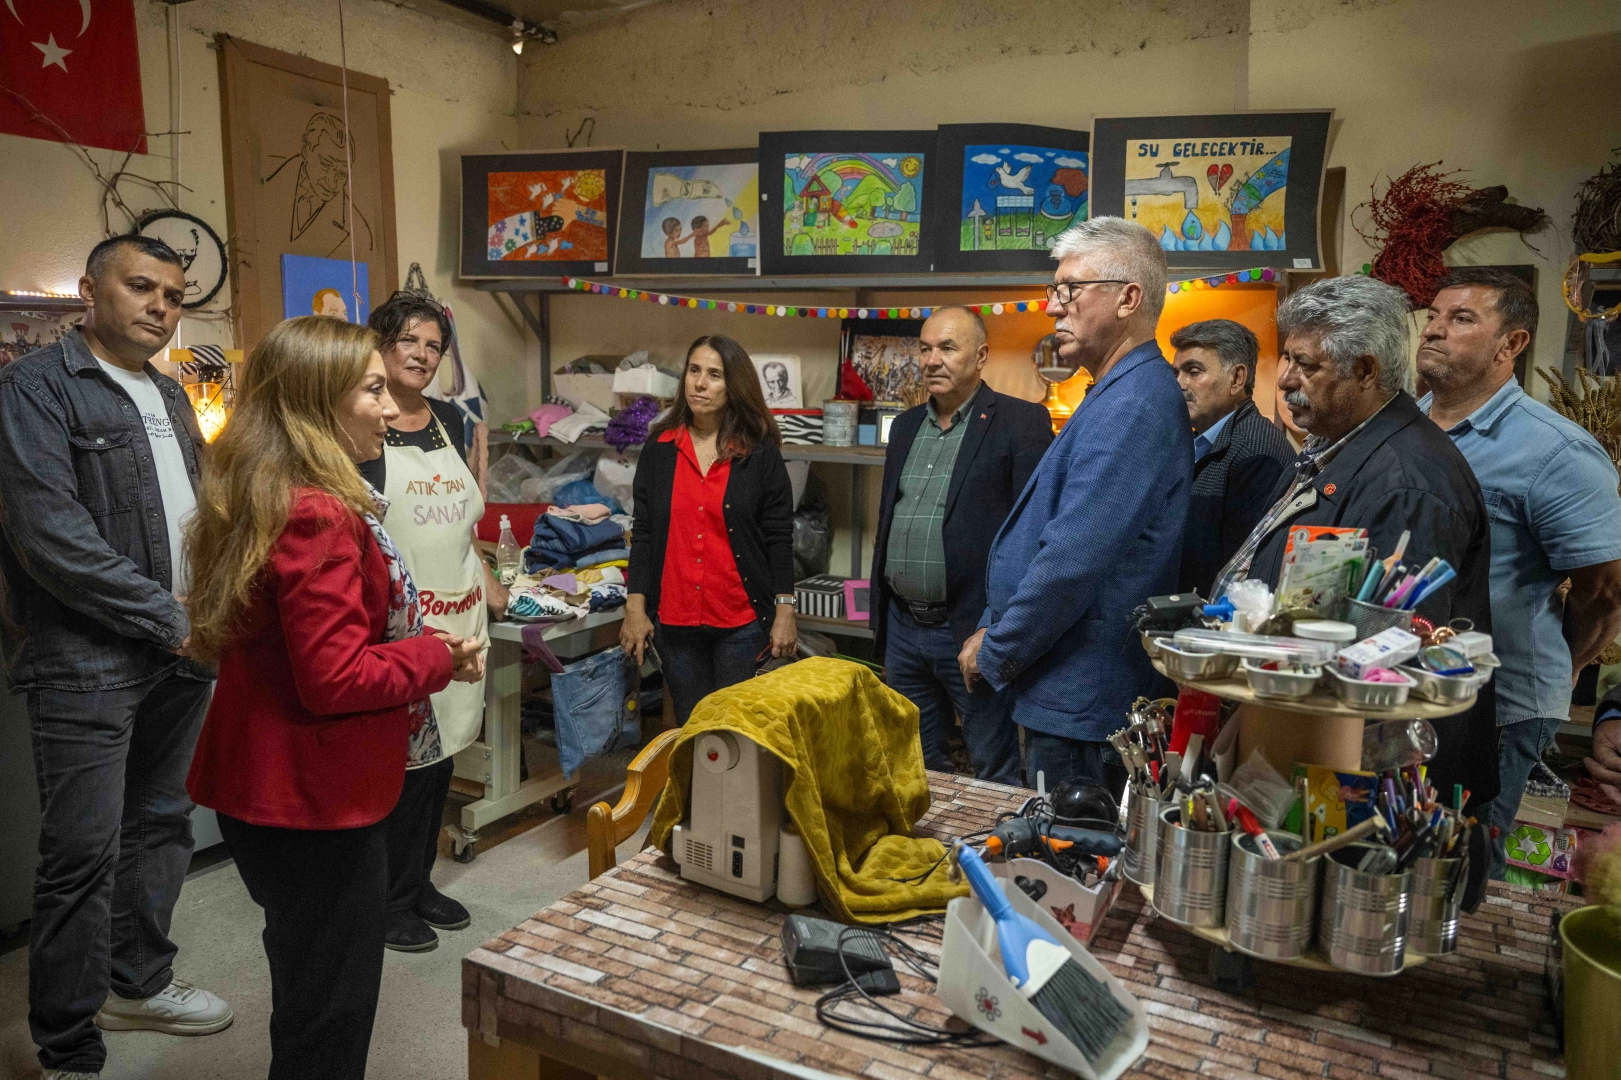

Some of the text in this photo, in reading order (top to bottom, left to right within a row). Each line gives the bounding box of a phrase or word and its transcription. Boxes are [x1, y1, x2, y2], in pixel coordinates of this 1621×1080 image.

[1138, 143, 1159, 158] SU
[405, 477, 466, 496] ATIK TAN
[413, 498, 469, 526] SANAT
